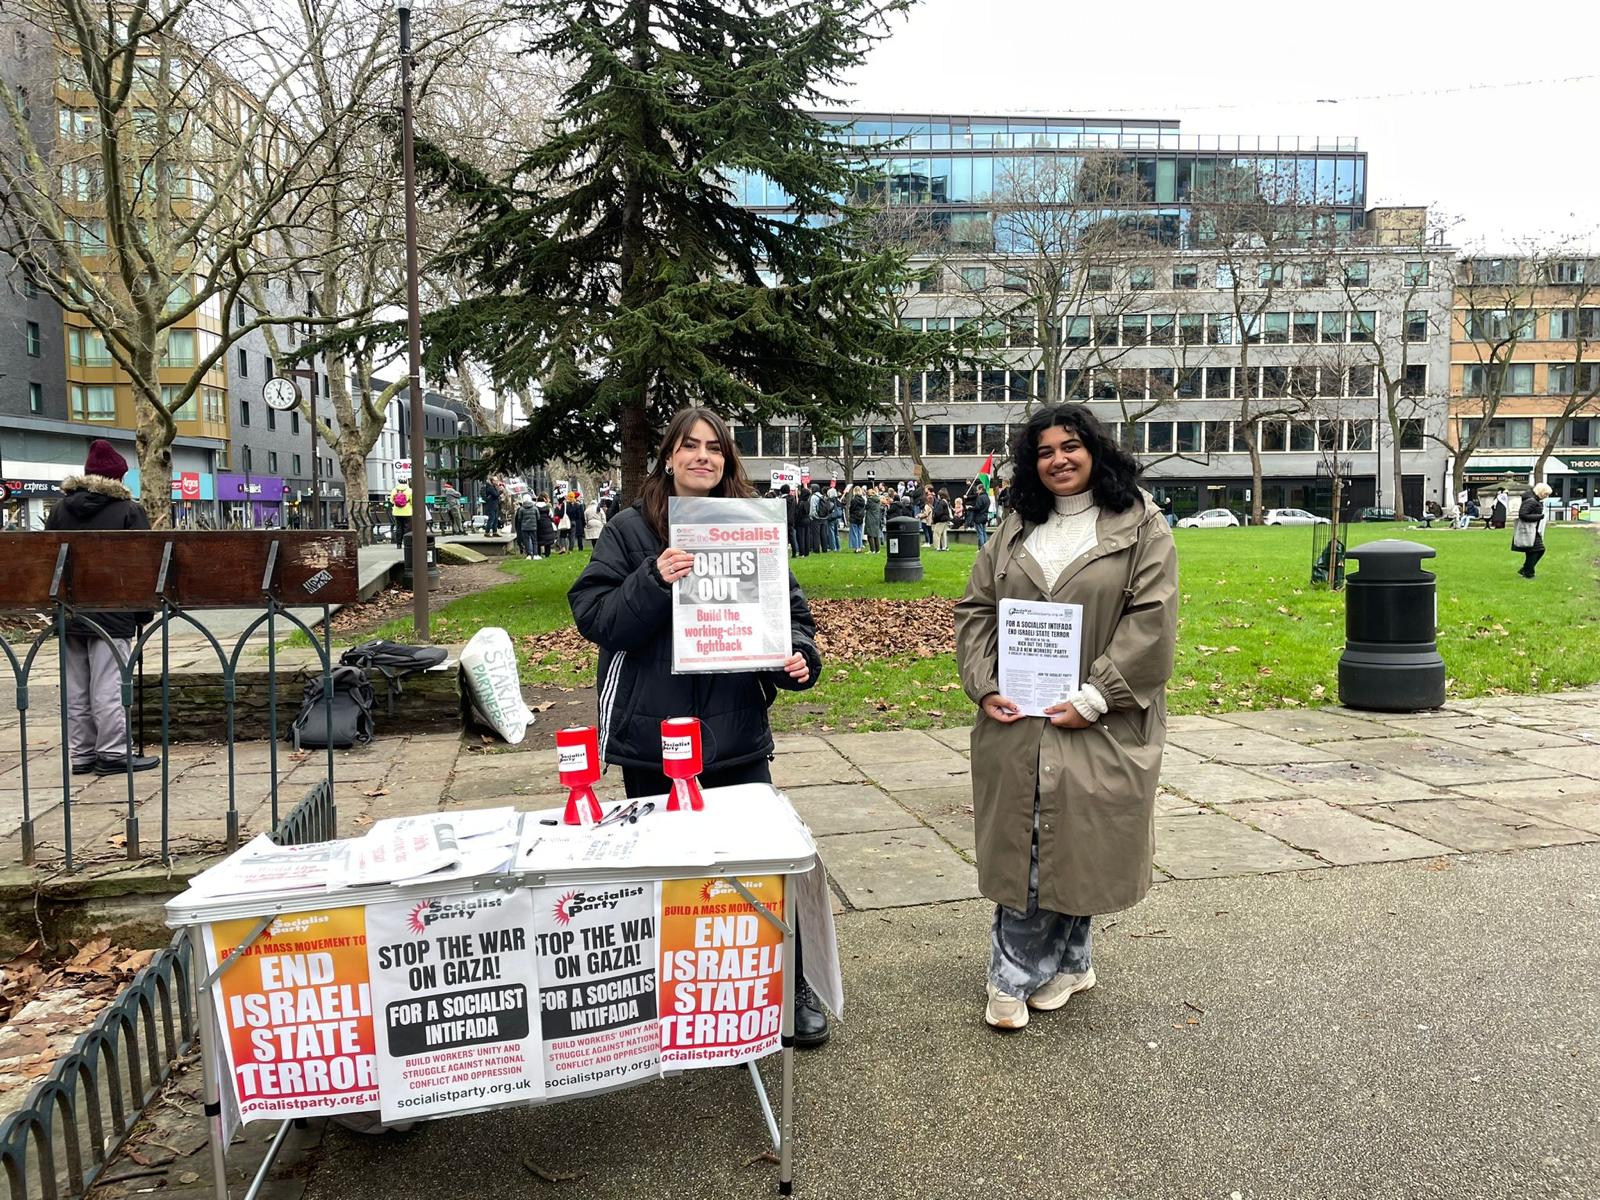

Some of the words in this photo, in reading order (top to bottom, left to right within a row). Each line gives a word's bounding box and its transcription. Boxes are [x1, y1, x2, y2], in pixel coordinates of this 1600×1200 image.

[24, 482, 49, 493] express
[183, 477, 199, 490] Argos
[709, 527, 780, 542] Socialist
[692, 551, 756, 577] ORIES
[698, 577, 741, 602] OUT
[696, 608, 722, 622] Build
[723, 608, 740, 621] the
[1006, 620, 1016, 628] FOR
[1021, 621, 1047, 629] SOCIALIST
[684, 624, 753, 640] working-class
[696, 639, 743, 656] fightback
[472, 664, 505, 729] PARTNERS
[484, 650, 523, 735] STARMER
[429, 898, 503, 913] Socialist
[568, 900, 619, 918] Party
[573, 886, 644, 906] Socialist
[664, 906, 691, 917] BUILD
[692, 905, 699, 915] A
[700, 903, 727, 915] MASS
[270, 924, 310, 936] Party
[272, 915, 330, 928] Socialist
[423, 909, 476, 926] Party
[695, 915, 758, 948] END
[254, 944, 262, 956] A
[263, 942, 294, 955] MASS
[294, 937, 351, 952] MOVEMENT
[353, 935, 367, 947] TO
[378, 939, 430, 970] STOP
[436, 934, 474, 961] THE
[478, 927, 526, 955] WAR
[580, 924, 616, 951] THE
[259, 952, 335, 991] END
[408, 964, 437, 992] ON
[443, 956, 502, 986] GAZA!
[554, 954, 581, 980] ON
[586, 943, 642, 975] GAZA!
[662, 942, 784, 983] ISRAELI
[229, 982, 372, 1029] ISRAELI
[539, 990, 568, 1012] FOR
[571, 988, 584, 1008] A
[586, 973, 656, 1006] SOCIALIS
[674, 976, 770, 1014] STATE
[389, 1003, 423, 1028] FOR
[427, 999, 440, 1022] A
[442, 988, 524, 1019] SOCIALIST
[570, 999, 640, 1031] INTIFADA
[424, 1016, 499, 1046] INTIFADA
[551, 1040, 576, 1051] BUILD
[619, 1027, 642, 1038] UNITY
[643, 1022, 659, 1033] AND
[659, 1004, 780, 1049] TERROR
[250, 1020, 361, 1062] STATE
[549, 1048, 590, 1062] STRUGGLE
[591, 1040, 625, 1055] AGAINST
[626, 1033, 660, 1047] NATIONA
[661, 1037, 778, 1063] ocialistparty.org.uk
[402, 1065, 447, 1080] STRUGGLE
[447, 1059, 484, 1073] AGAINST
[485, 1055, 526, 1067] NATIONAL
[405, 1056, 431, 1068] BUILD
[432, 1050, 476, 1063] WORKERS'
[477, 1045, 502, 1057] UNITY
[503, 1043, 521, 1053] AND
[555, 1058, 594, 1072] CONFLICT
[595, 1054, 612, 1065] AND
[613, 1043, 660, 1061] OPPRESSION
[235, 1054, 379, 1097] TERROR
[409, 1077, 451, 1090] CONFLICT
[451, 1073, 469, 1084] AND
[470, 1066, 522, 1080] OPPRESSION
[544, 1056, 661, 1089] socialistparty.org.u
[397, 1078, 532, 1109] socialistparty.org.uk
